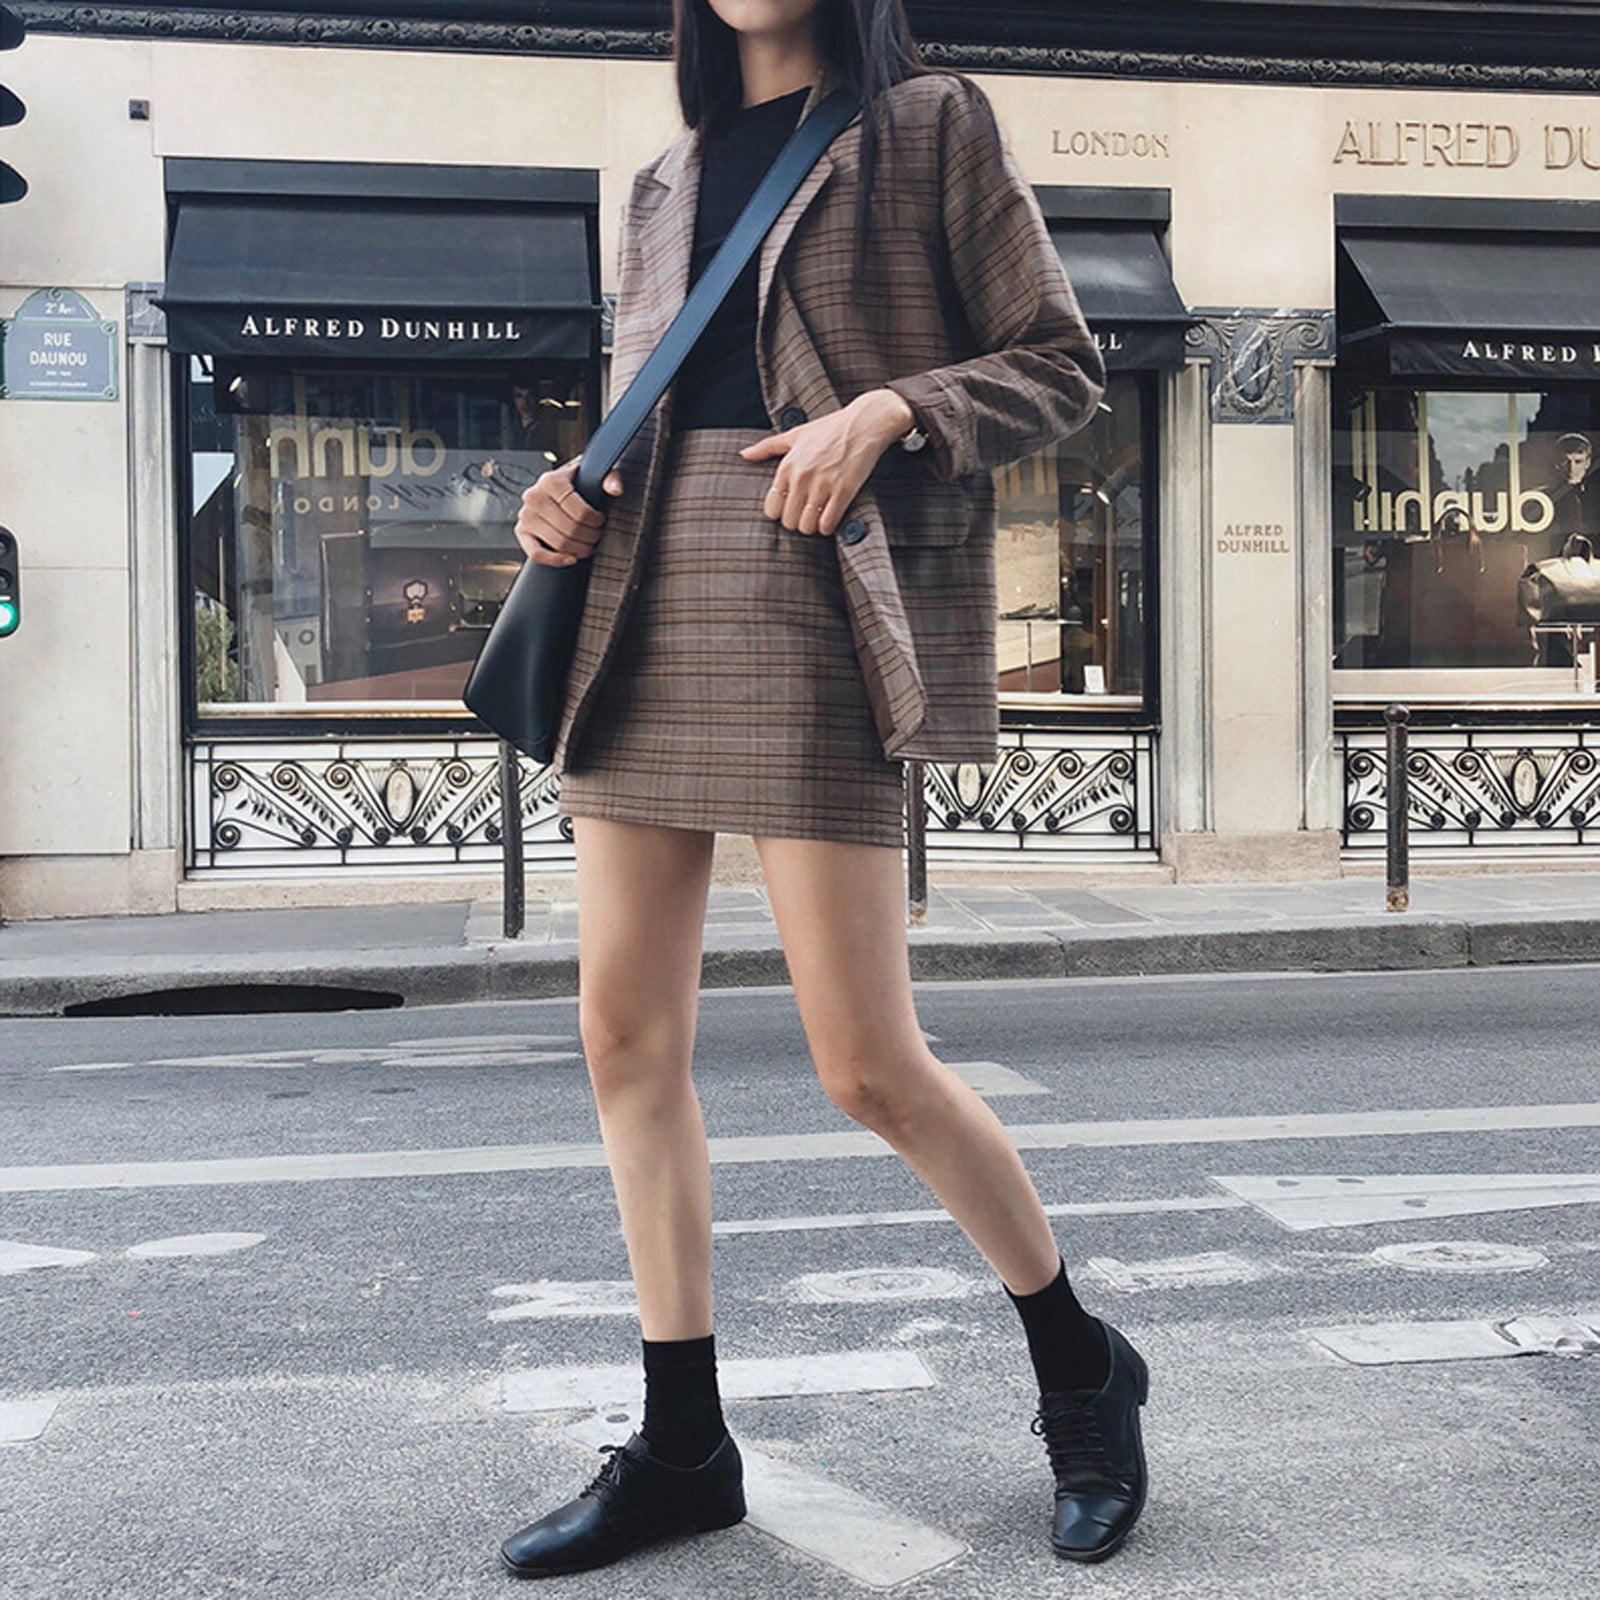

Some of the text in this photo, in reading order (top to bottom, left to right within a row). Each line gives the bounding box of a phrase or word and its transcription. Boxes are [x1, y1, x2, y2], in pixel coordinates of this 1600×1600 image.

[1051, 129, 1170, 159] LONDON
[1332, 119, 1520, 169] ALFRED
[240, 315, 521, 341] ALFRED DUNHILL
[43, 331, 73, 347] RUE
[29, 350, 88, 367] DAUNOU
[1462, 340, 1578, 362] ALFRED
[1223, 523, 1284, 537] ALFRED
[1217, 539, 1291, 554] DUNHILL
